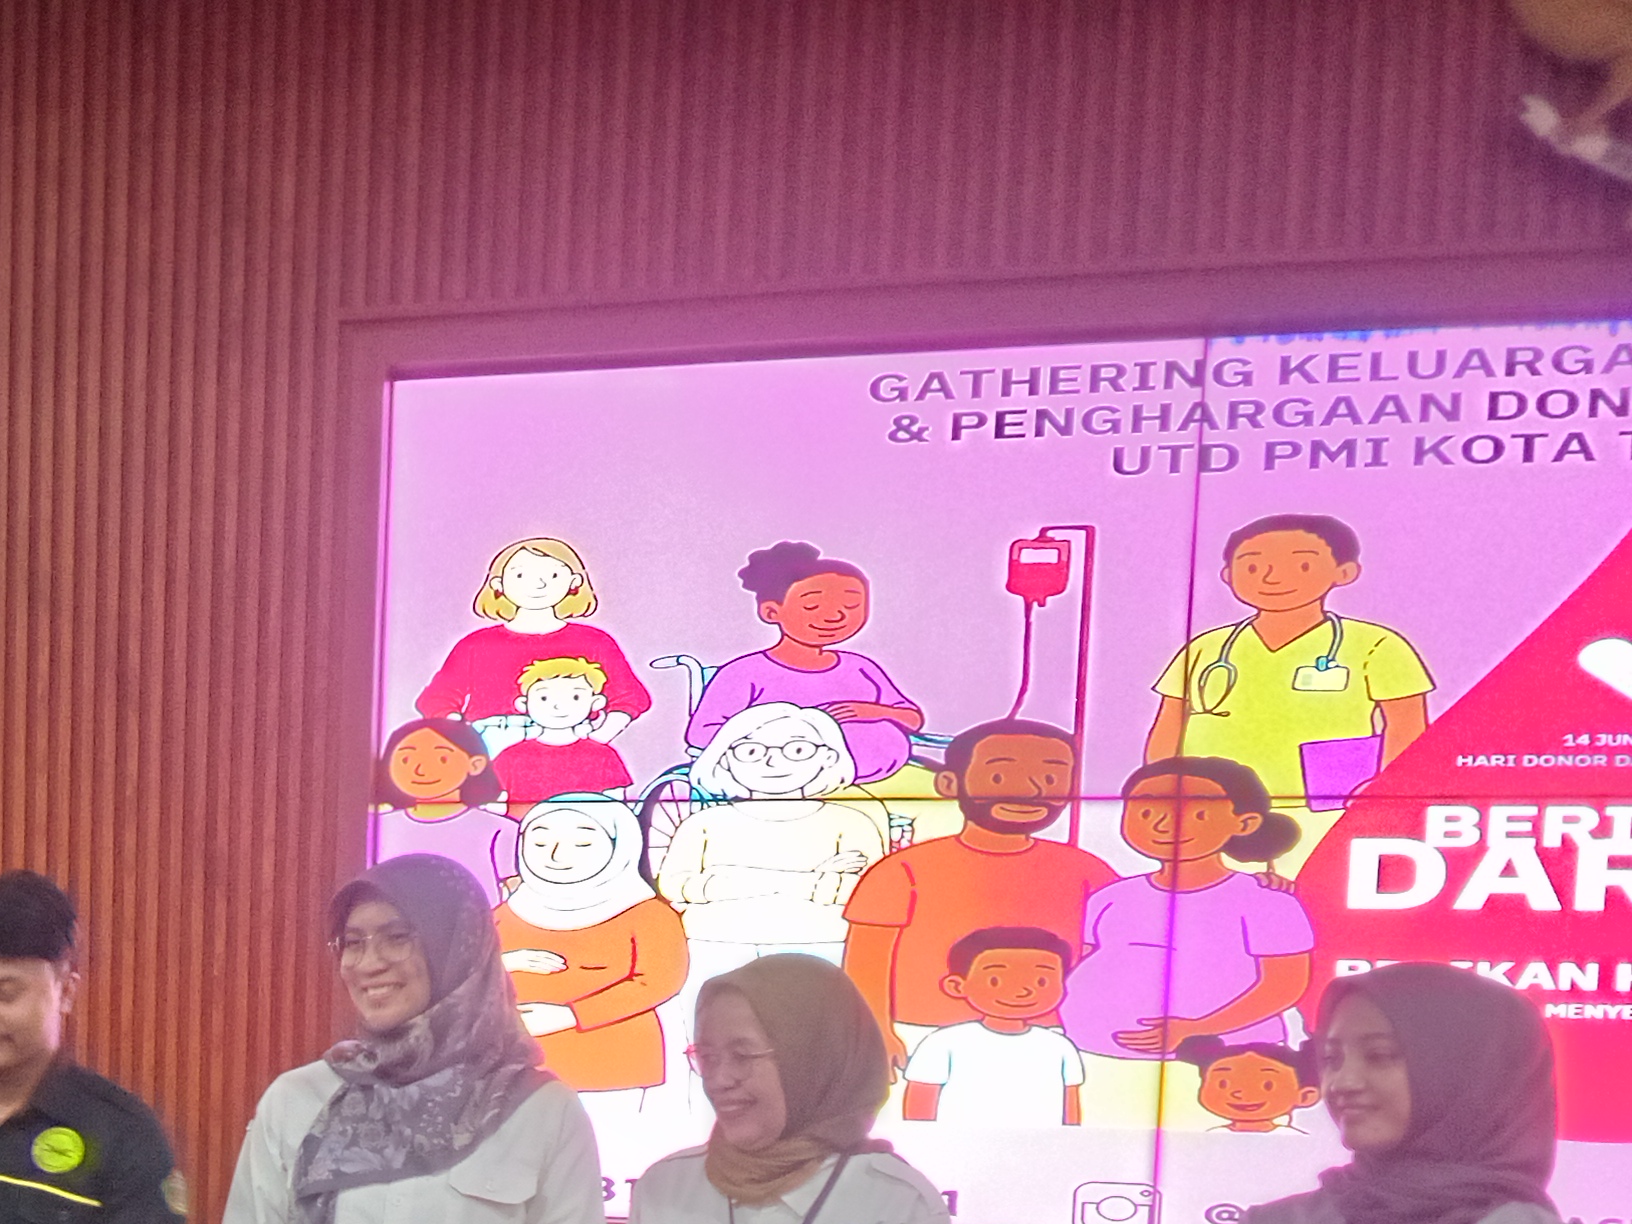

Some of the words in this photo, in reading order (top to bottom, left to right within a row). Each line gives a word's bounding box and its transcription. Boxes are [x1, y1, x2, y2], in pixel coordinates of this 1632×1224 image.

[868, 357, 1255, 403] GATHERING
[1277, 343, 1632, 386] KELUARGA
[887, 413, 930, 443] &
[950, 392, 1463, 441] PENGHARGAAN
[1112, 443, 1240, 476] UTD
[1263, 437, 1390, 471] PMI
[1413, 431, 1597, 467] KOTA
[1456, 754, 1517, 767] HARI
[1521, 754, 1608, 767] DONOR
[1562, 733, 1591, 747] 14
[1346, 837, 1632, 911] DAR
